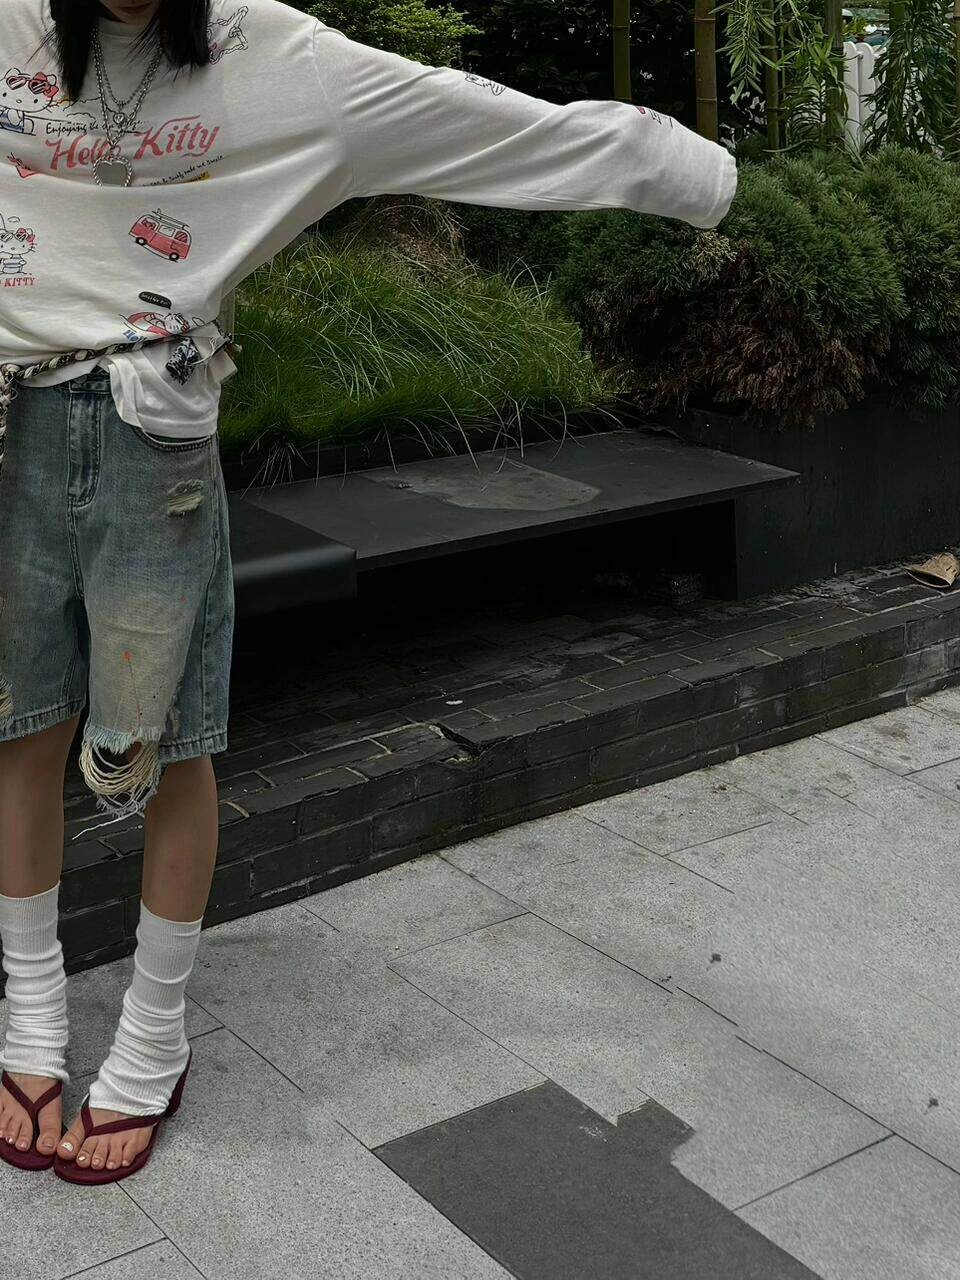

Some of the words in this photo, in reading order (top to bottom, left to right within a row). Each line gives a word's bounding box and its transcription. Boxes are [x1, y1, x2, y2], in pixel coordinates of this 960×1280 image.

[46, 122, 87, 137] Enjoying
[133, 115, 221, 160] Kitty
[4, 277, 35, 287] KITTY
